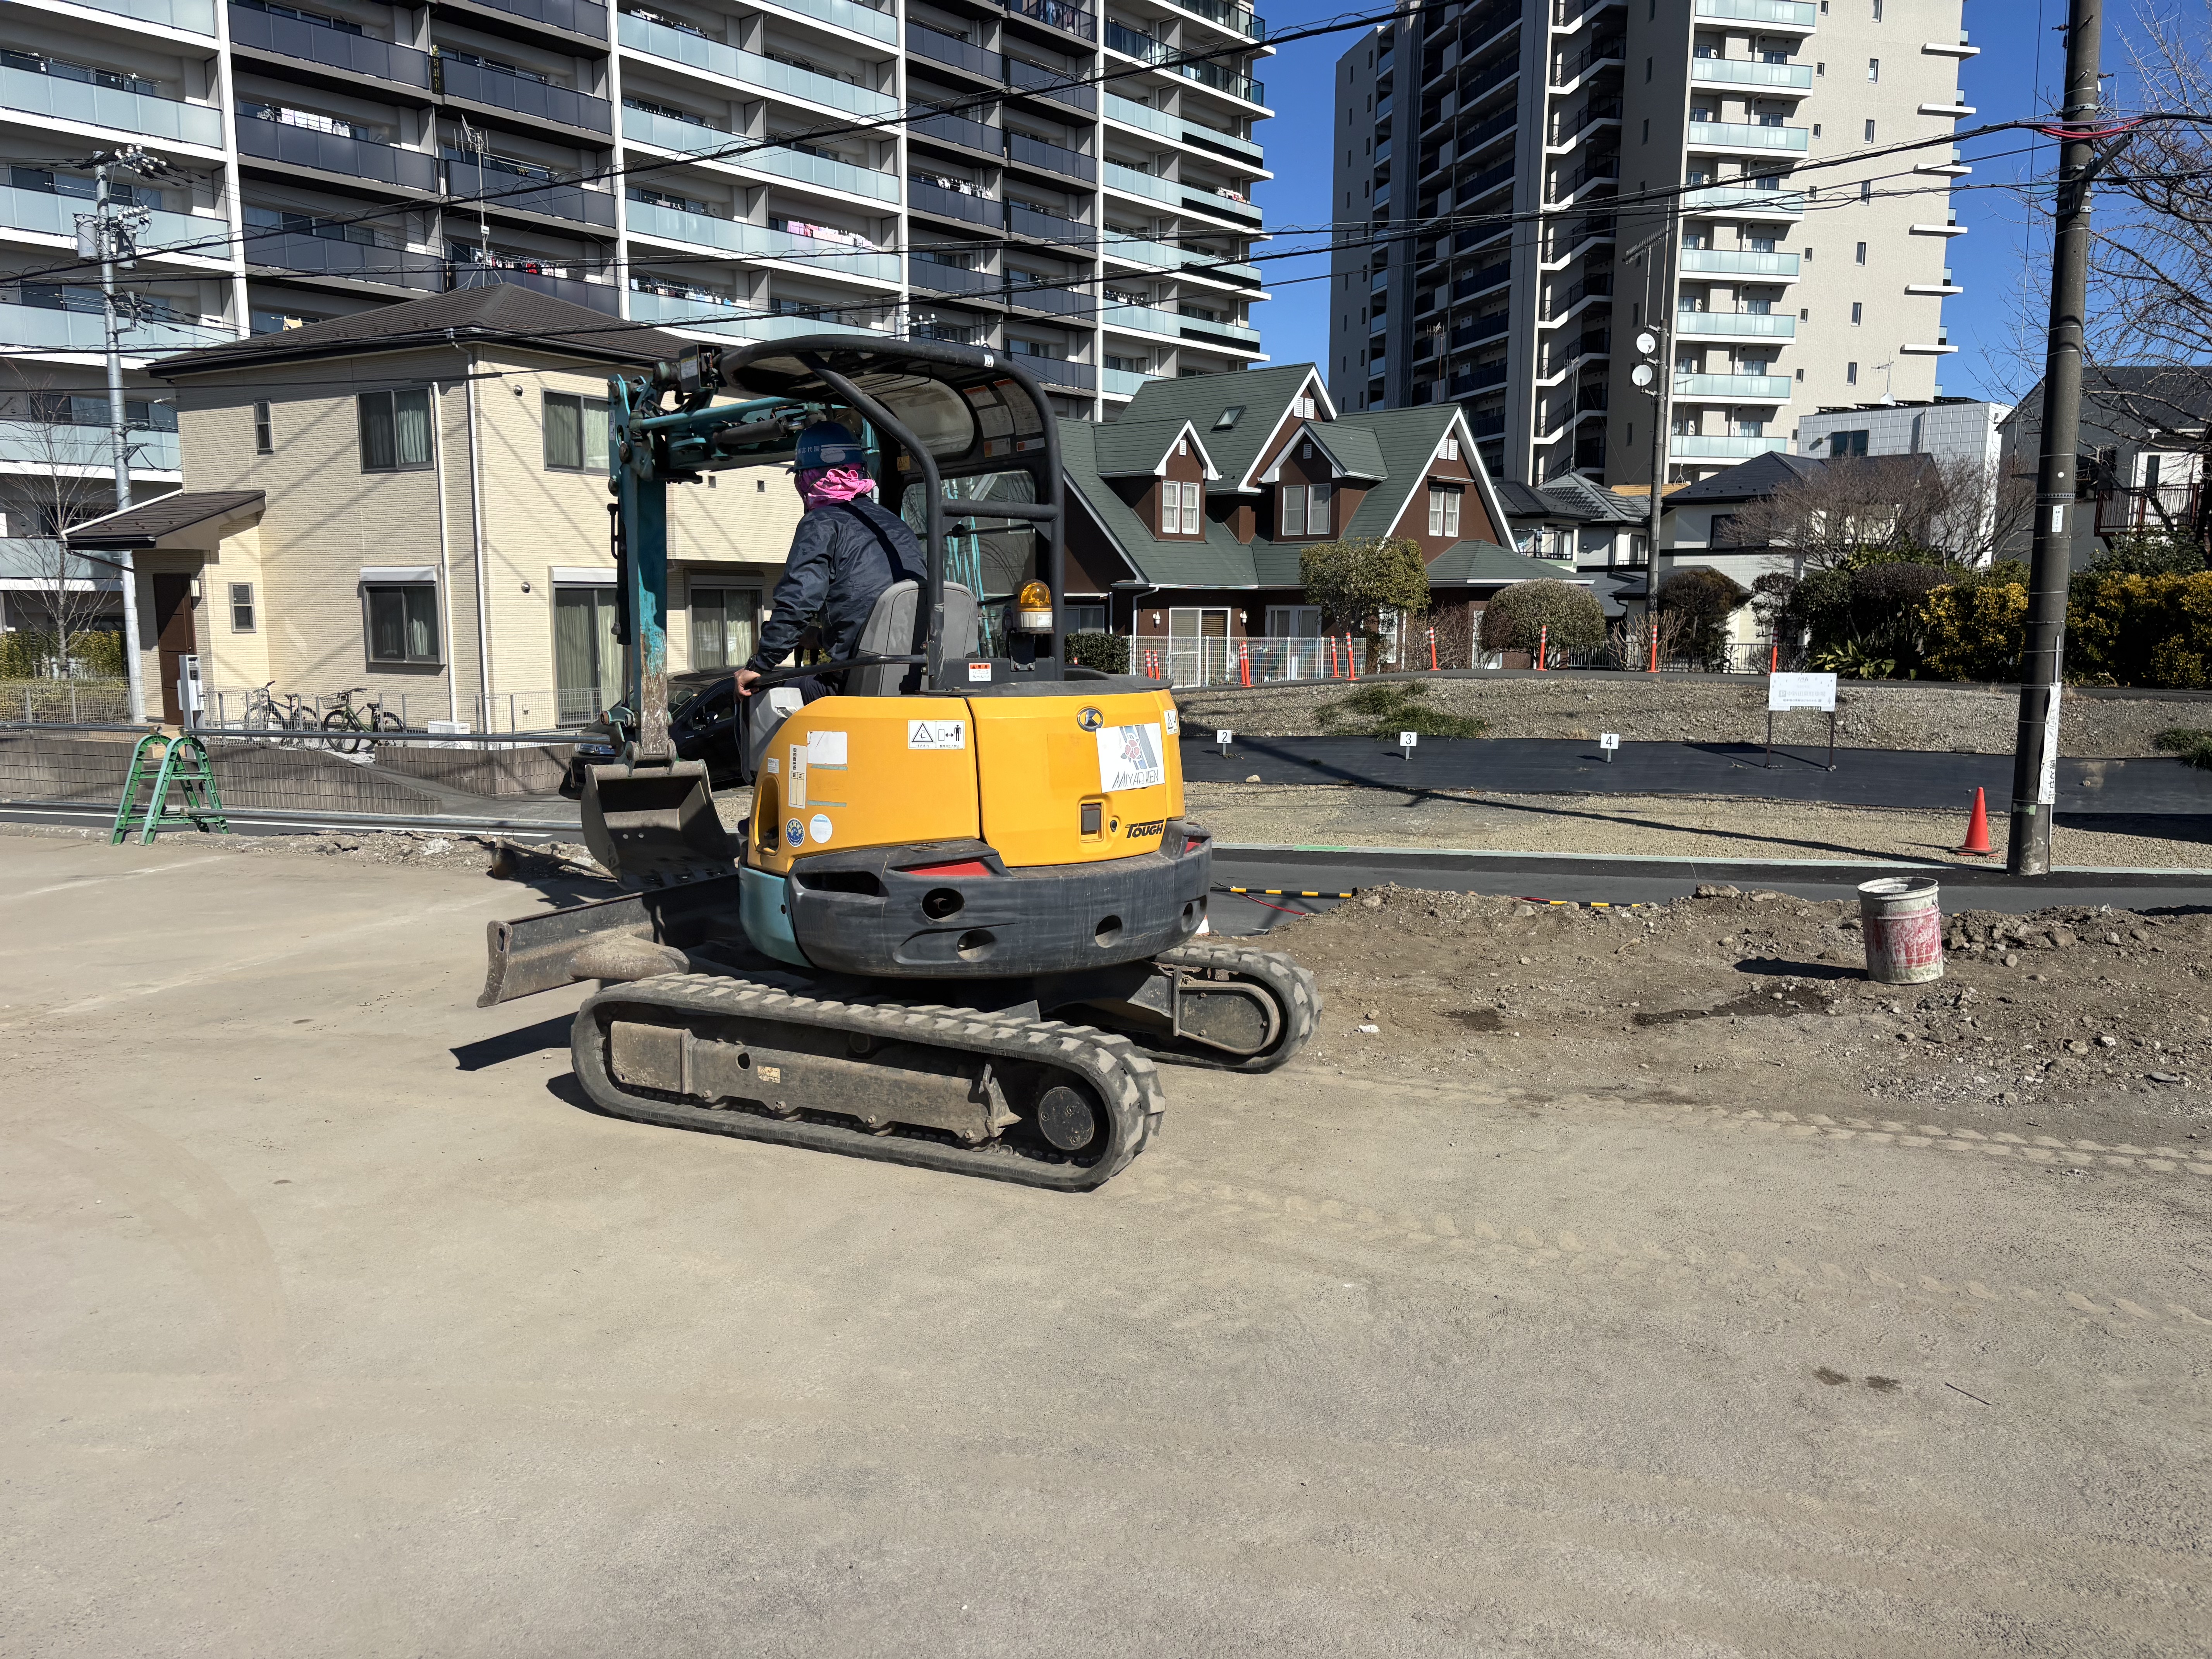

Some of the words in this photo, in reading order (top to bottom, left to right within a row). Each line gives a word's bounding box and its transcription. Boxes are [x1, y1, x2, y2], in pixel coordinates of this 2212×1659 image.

[1222, 732, 1227, 742] 2
[1405, 734, 1411, 745] 3
[1606, 735, 1613, 747] 4
[1125, 819, 1164, 838] TOUGH
